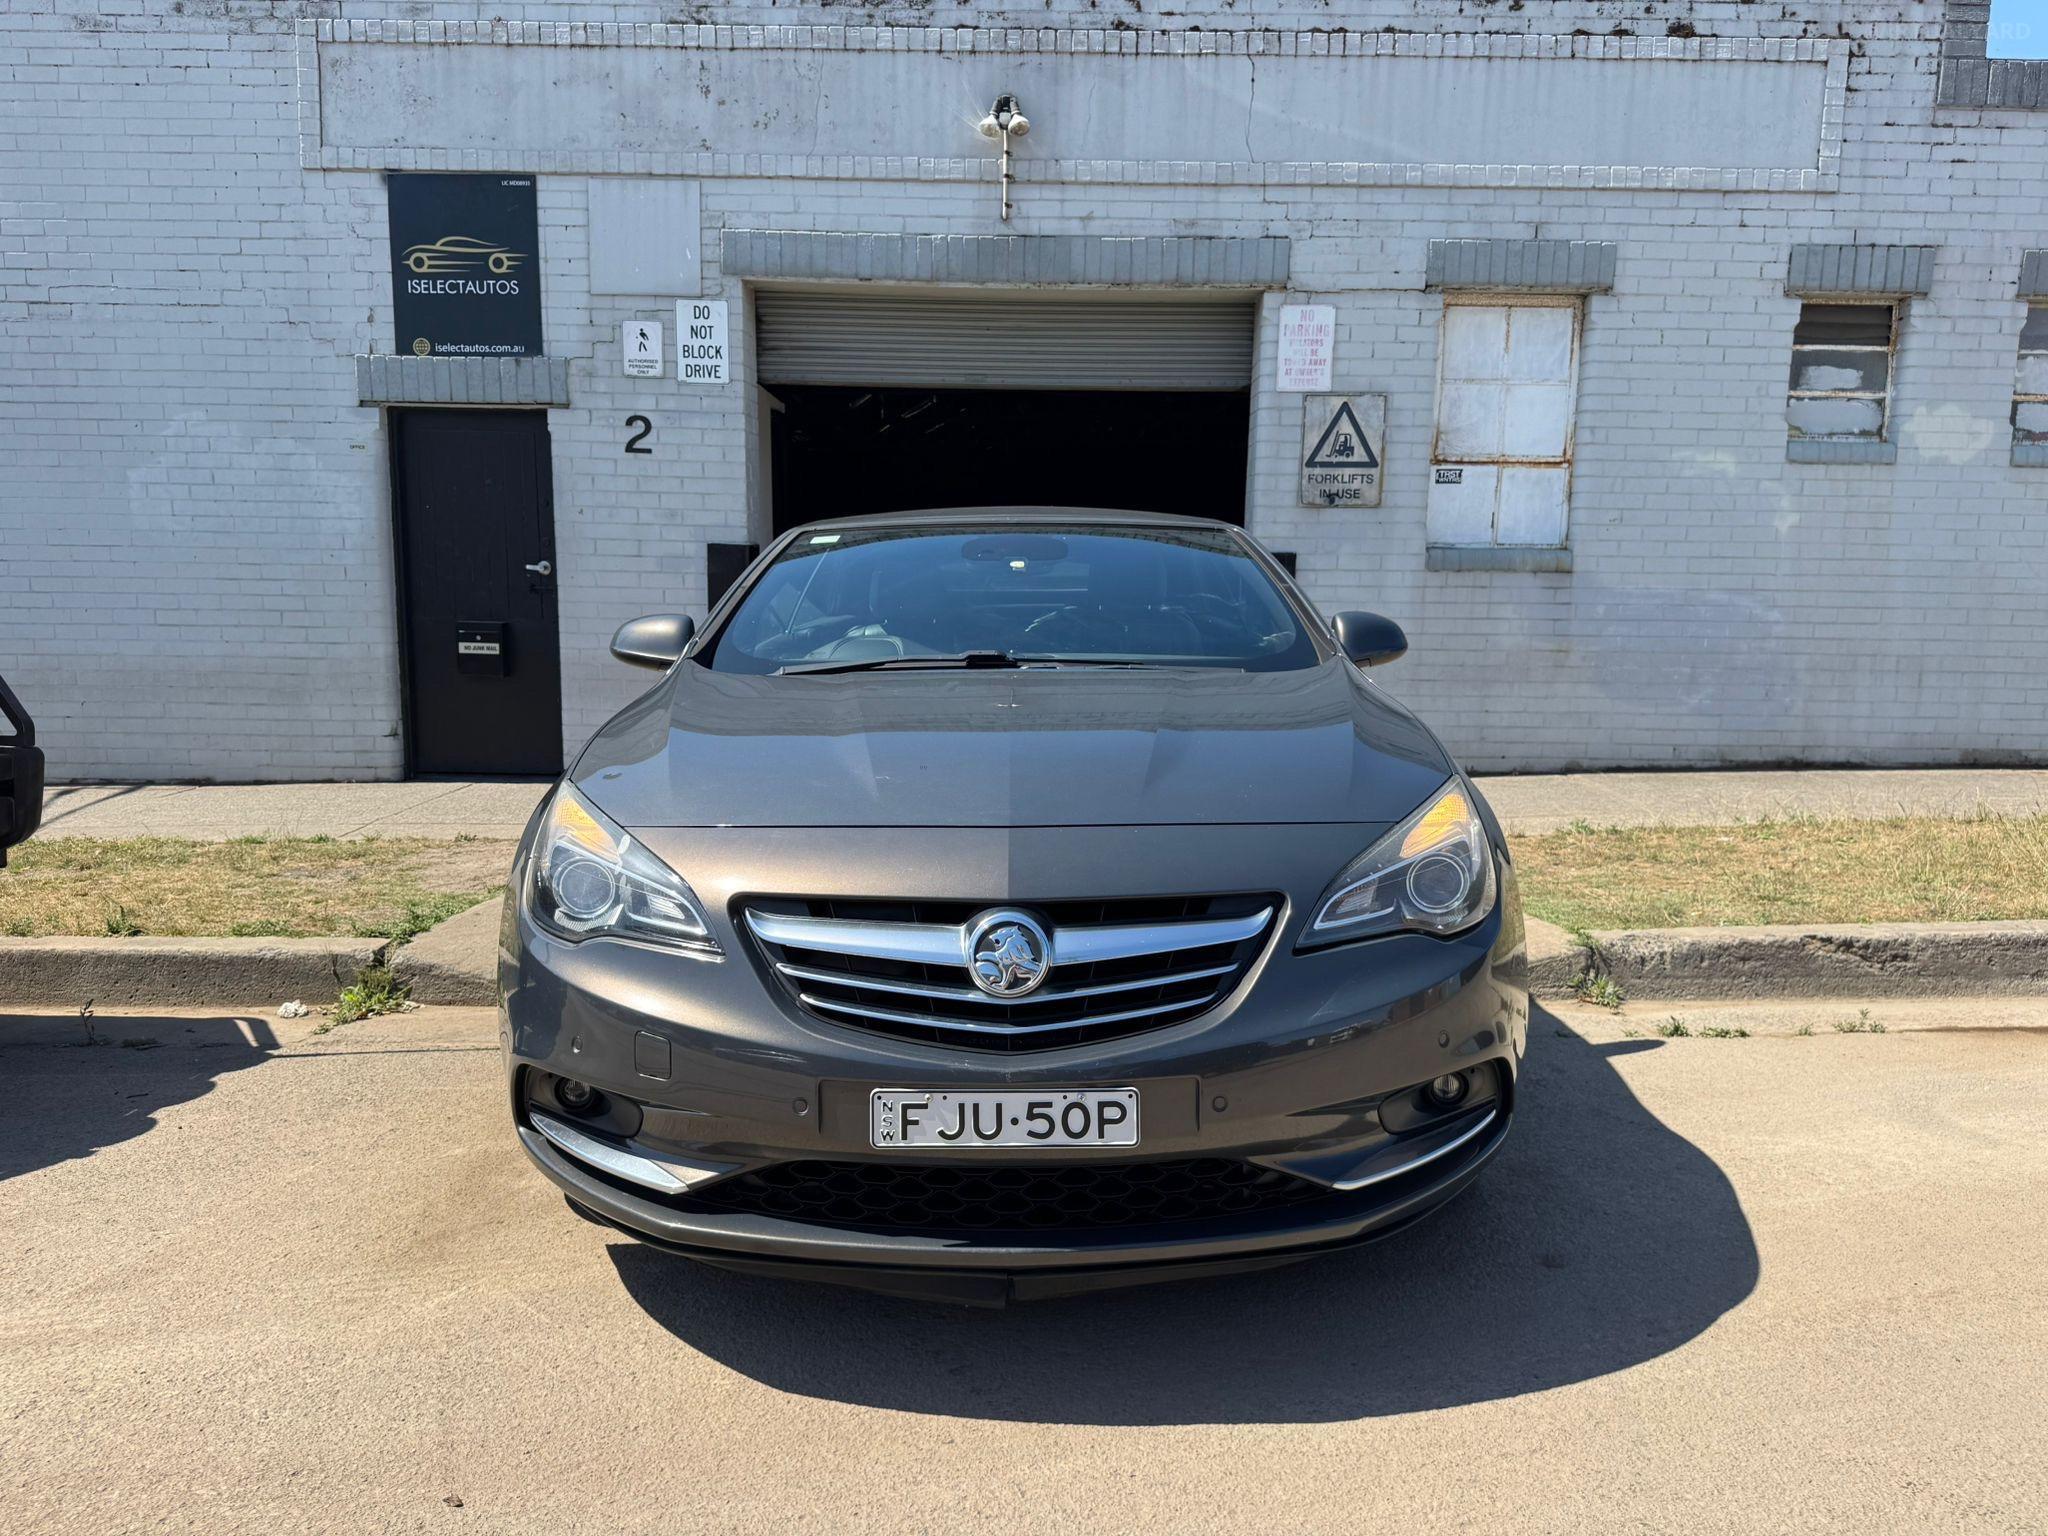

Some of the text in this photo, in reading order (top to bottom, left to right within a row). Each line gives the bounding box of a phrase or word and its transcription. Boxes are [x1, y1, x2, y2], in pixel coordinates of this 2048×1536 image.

[407, 279, 520, 295] ISELECTAUTOS
[693, 305, 711, 320] DO
[1300, 309, 1315, 322] NO
[690, 325, 714, 340] NOT
[1283, 323, 1330, 337] PARKING
[435, 342, 525, 353] iselectautos.com.au
[1288, 338, 1324, 347] VILATORS
[682, 345, 723, 360] BLOCK
[1310, 348, 1319, 357] BE
[1284, 358, 1328, 367] TOD AWAY
[685, 364, 722, 379] DRIVE
[1284, 367, 1293, 377] AT
[624, 414, 652, 454] 2
[1307, 473, 1374, 484] FORKLIFTS
[1319, 488, 1361, 499] IN USE
